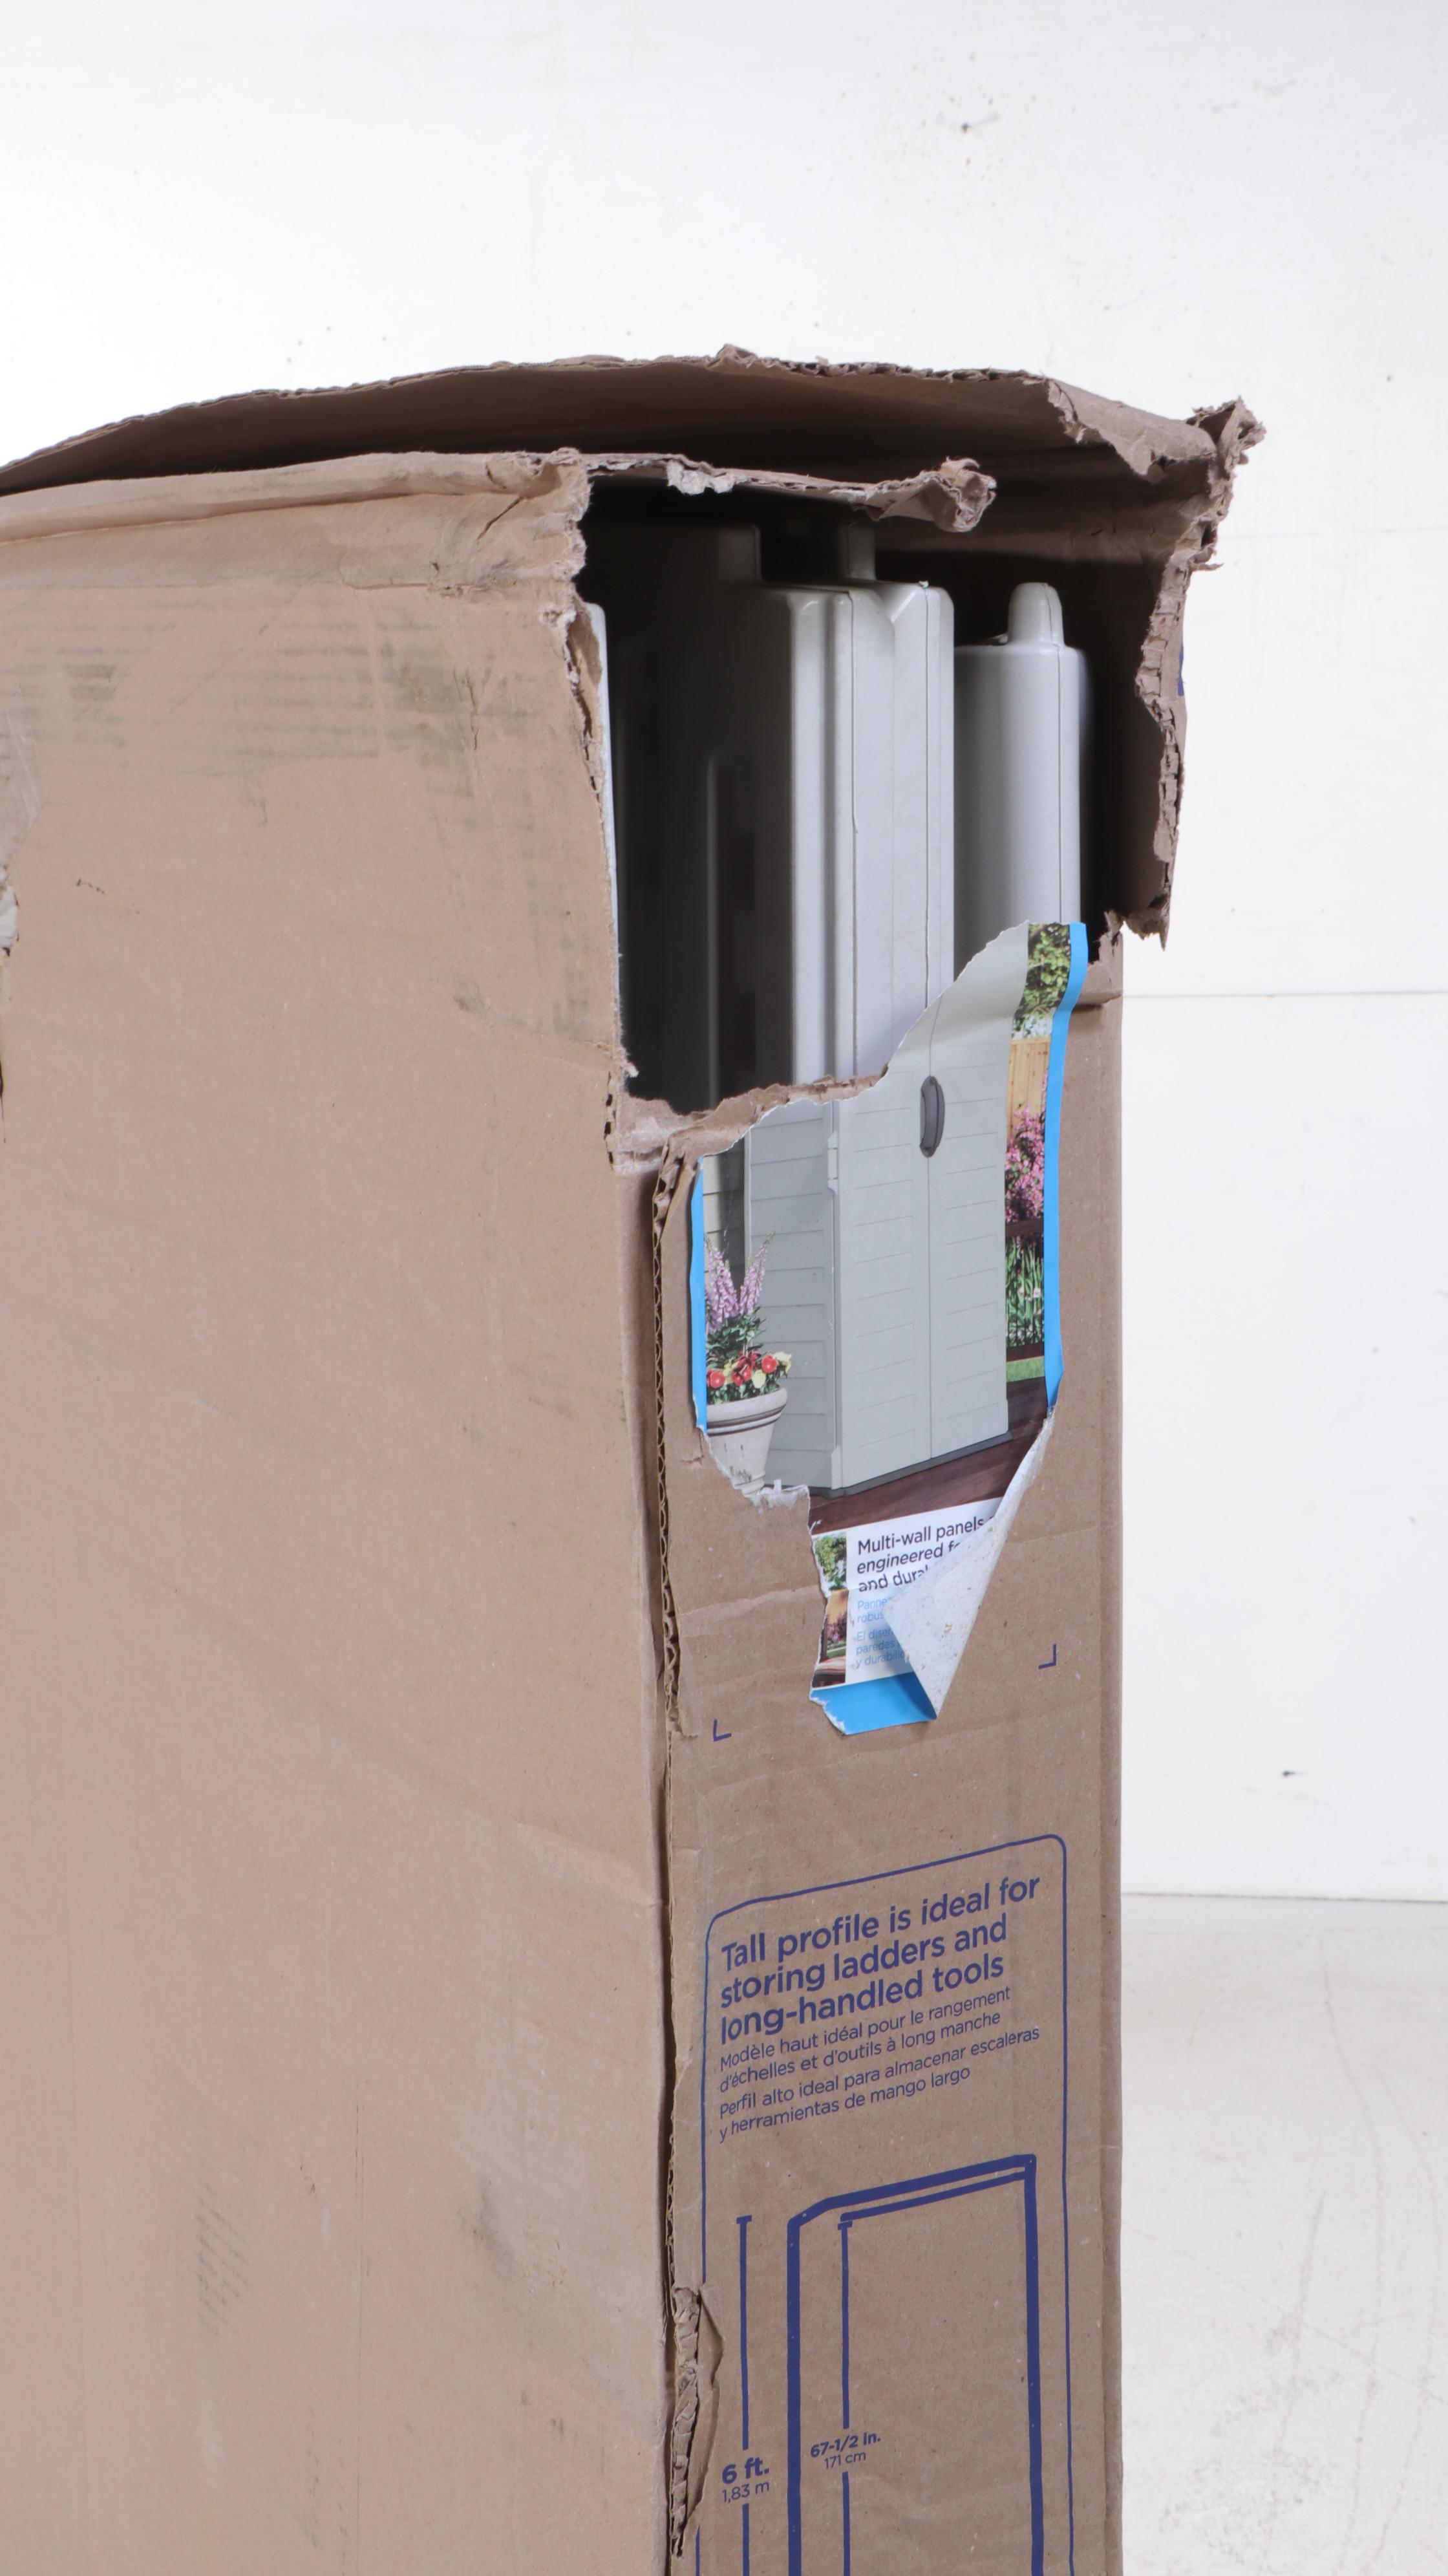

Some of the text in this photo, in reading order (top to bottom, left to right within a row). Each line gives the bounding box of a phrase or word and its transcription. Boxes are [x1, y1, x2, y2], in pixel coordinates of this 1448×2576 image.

[858, 1516, 985, 1555] Multi-wall panels
[857, 1543, 944, 1574] engineered
[858, 1573, 888, 1592] and
[857, 1596, 893, 1611] Panne
[856, 1640, 895, 1657] paredes
[857, 1629, 866, 1642] El
[855, 1658, 862, 1669] y
[721, 1876, 1040, 1971] Tall profile is ideal for
[720, 1913, 1007, 2008] storing ladders and
[721, 1953, 1005, 2045] long-handled tools
[720, 1986, 1010, 2072] Modèle haut idéal pour le rangement
[800, 2055, 818, 2071] et
[886, 2037, 896, 2052] à
[901, 2029, 935, 2049] long
[940, 2012, 1001, 2039] manche
[720, 2027, 1040, 2120] Perfil alto ideal para almacenar escaleras
[719, 2066, 971, 2143] y herramientas de mango largo
[810, 2432, 881, 2458] 67-1/2 in.
[722, 2457, 770, 2484] 6 ft.
[825, 2451, 867, 2470] 171 cm
[722, 2482, 770, 2504] 1,83 m
